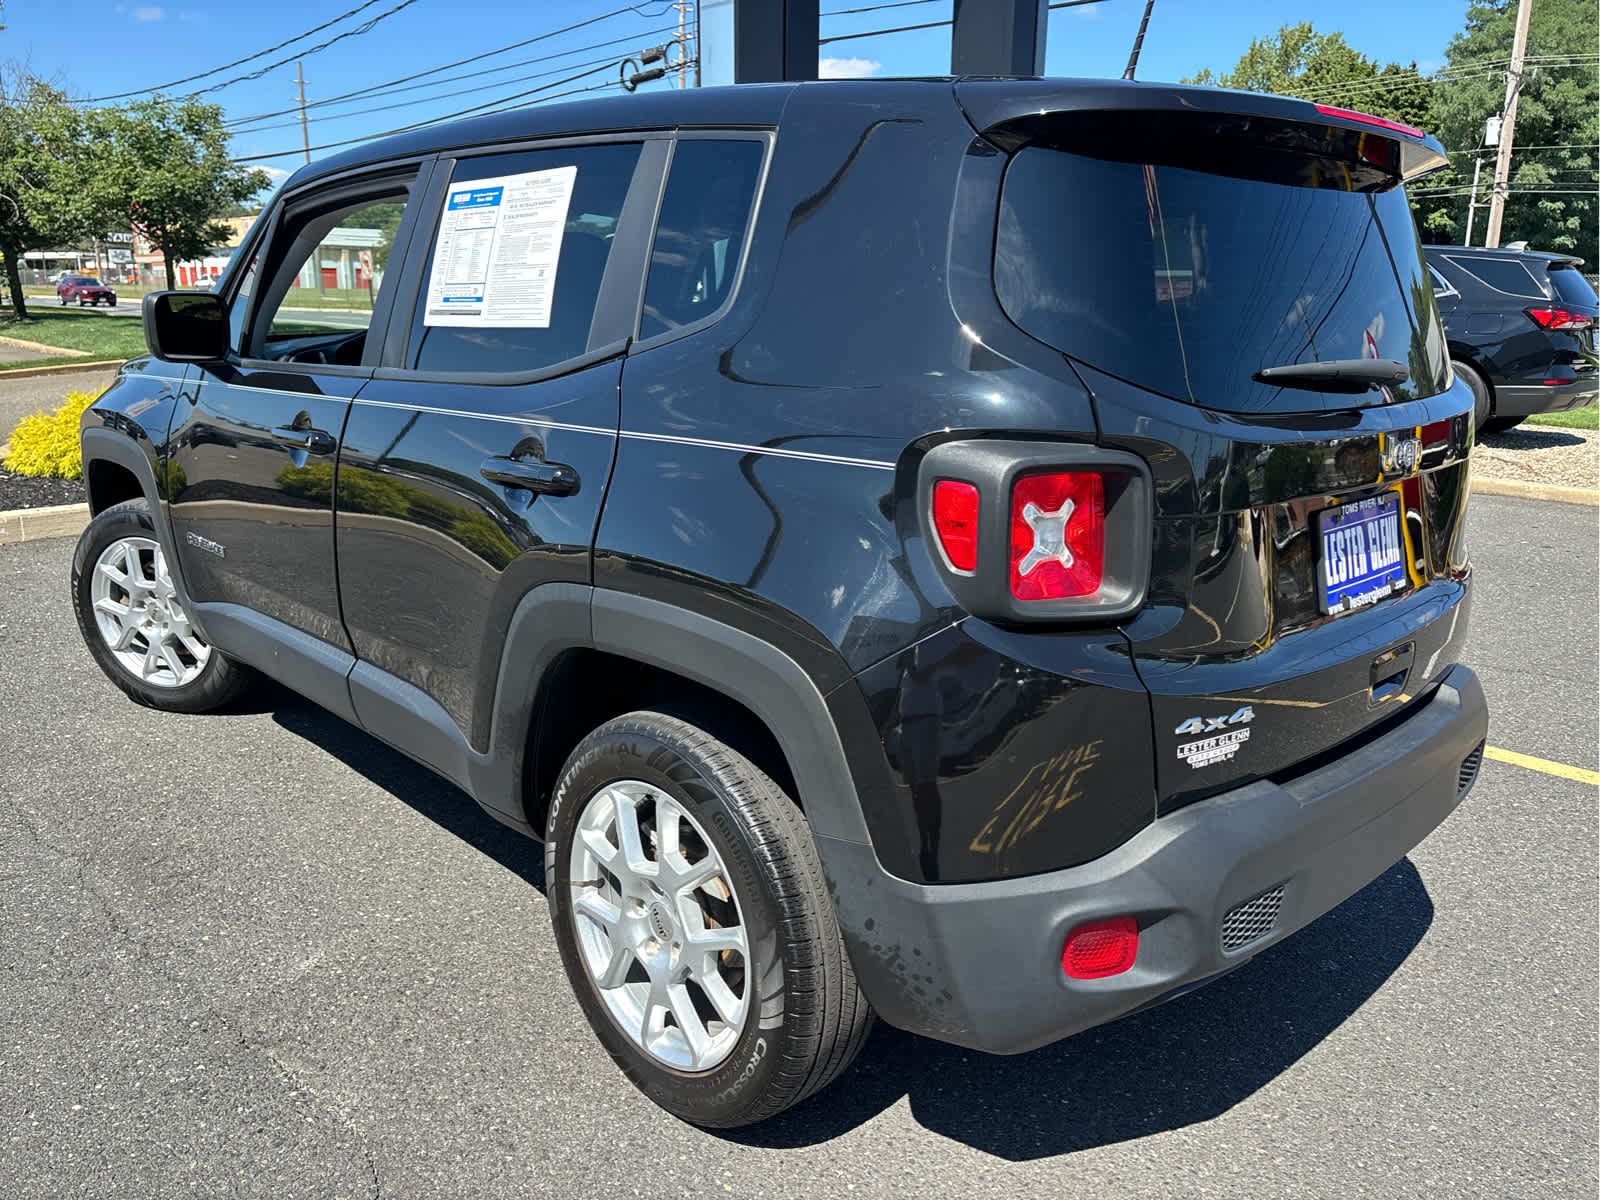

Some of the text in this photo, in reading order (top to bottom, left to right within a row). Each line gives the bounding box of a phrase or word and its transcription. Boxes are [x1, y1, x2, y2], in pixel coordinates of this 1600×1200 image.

[1379, 434, 1423, 474] Jeep
[1341, 502, 1359, 516] TOMS
[1324, 514, 1400, 586] LESTER GLENN
[1177, 730, 1249, 757] LESTER GLENN
